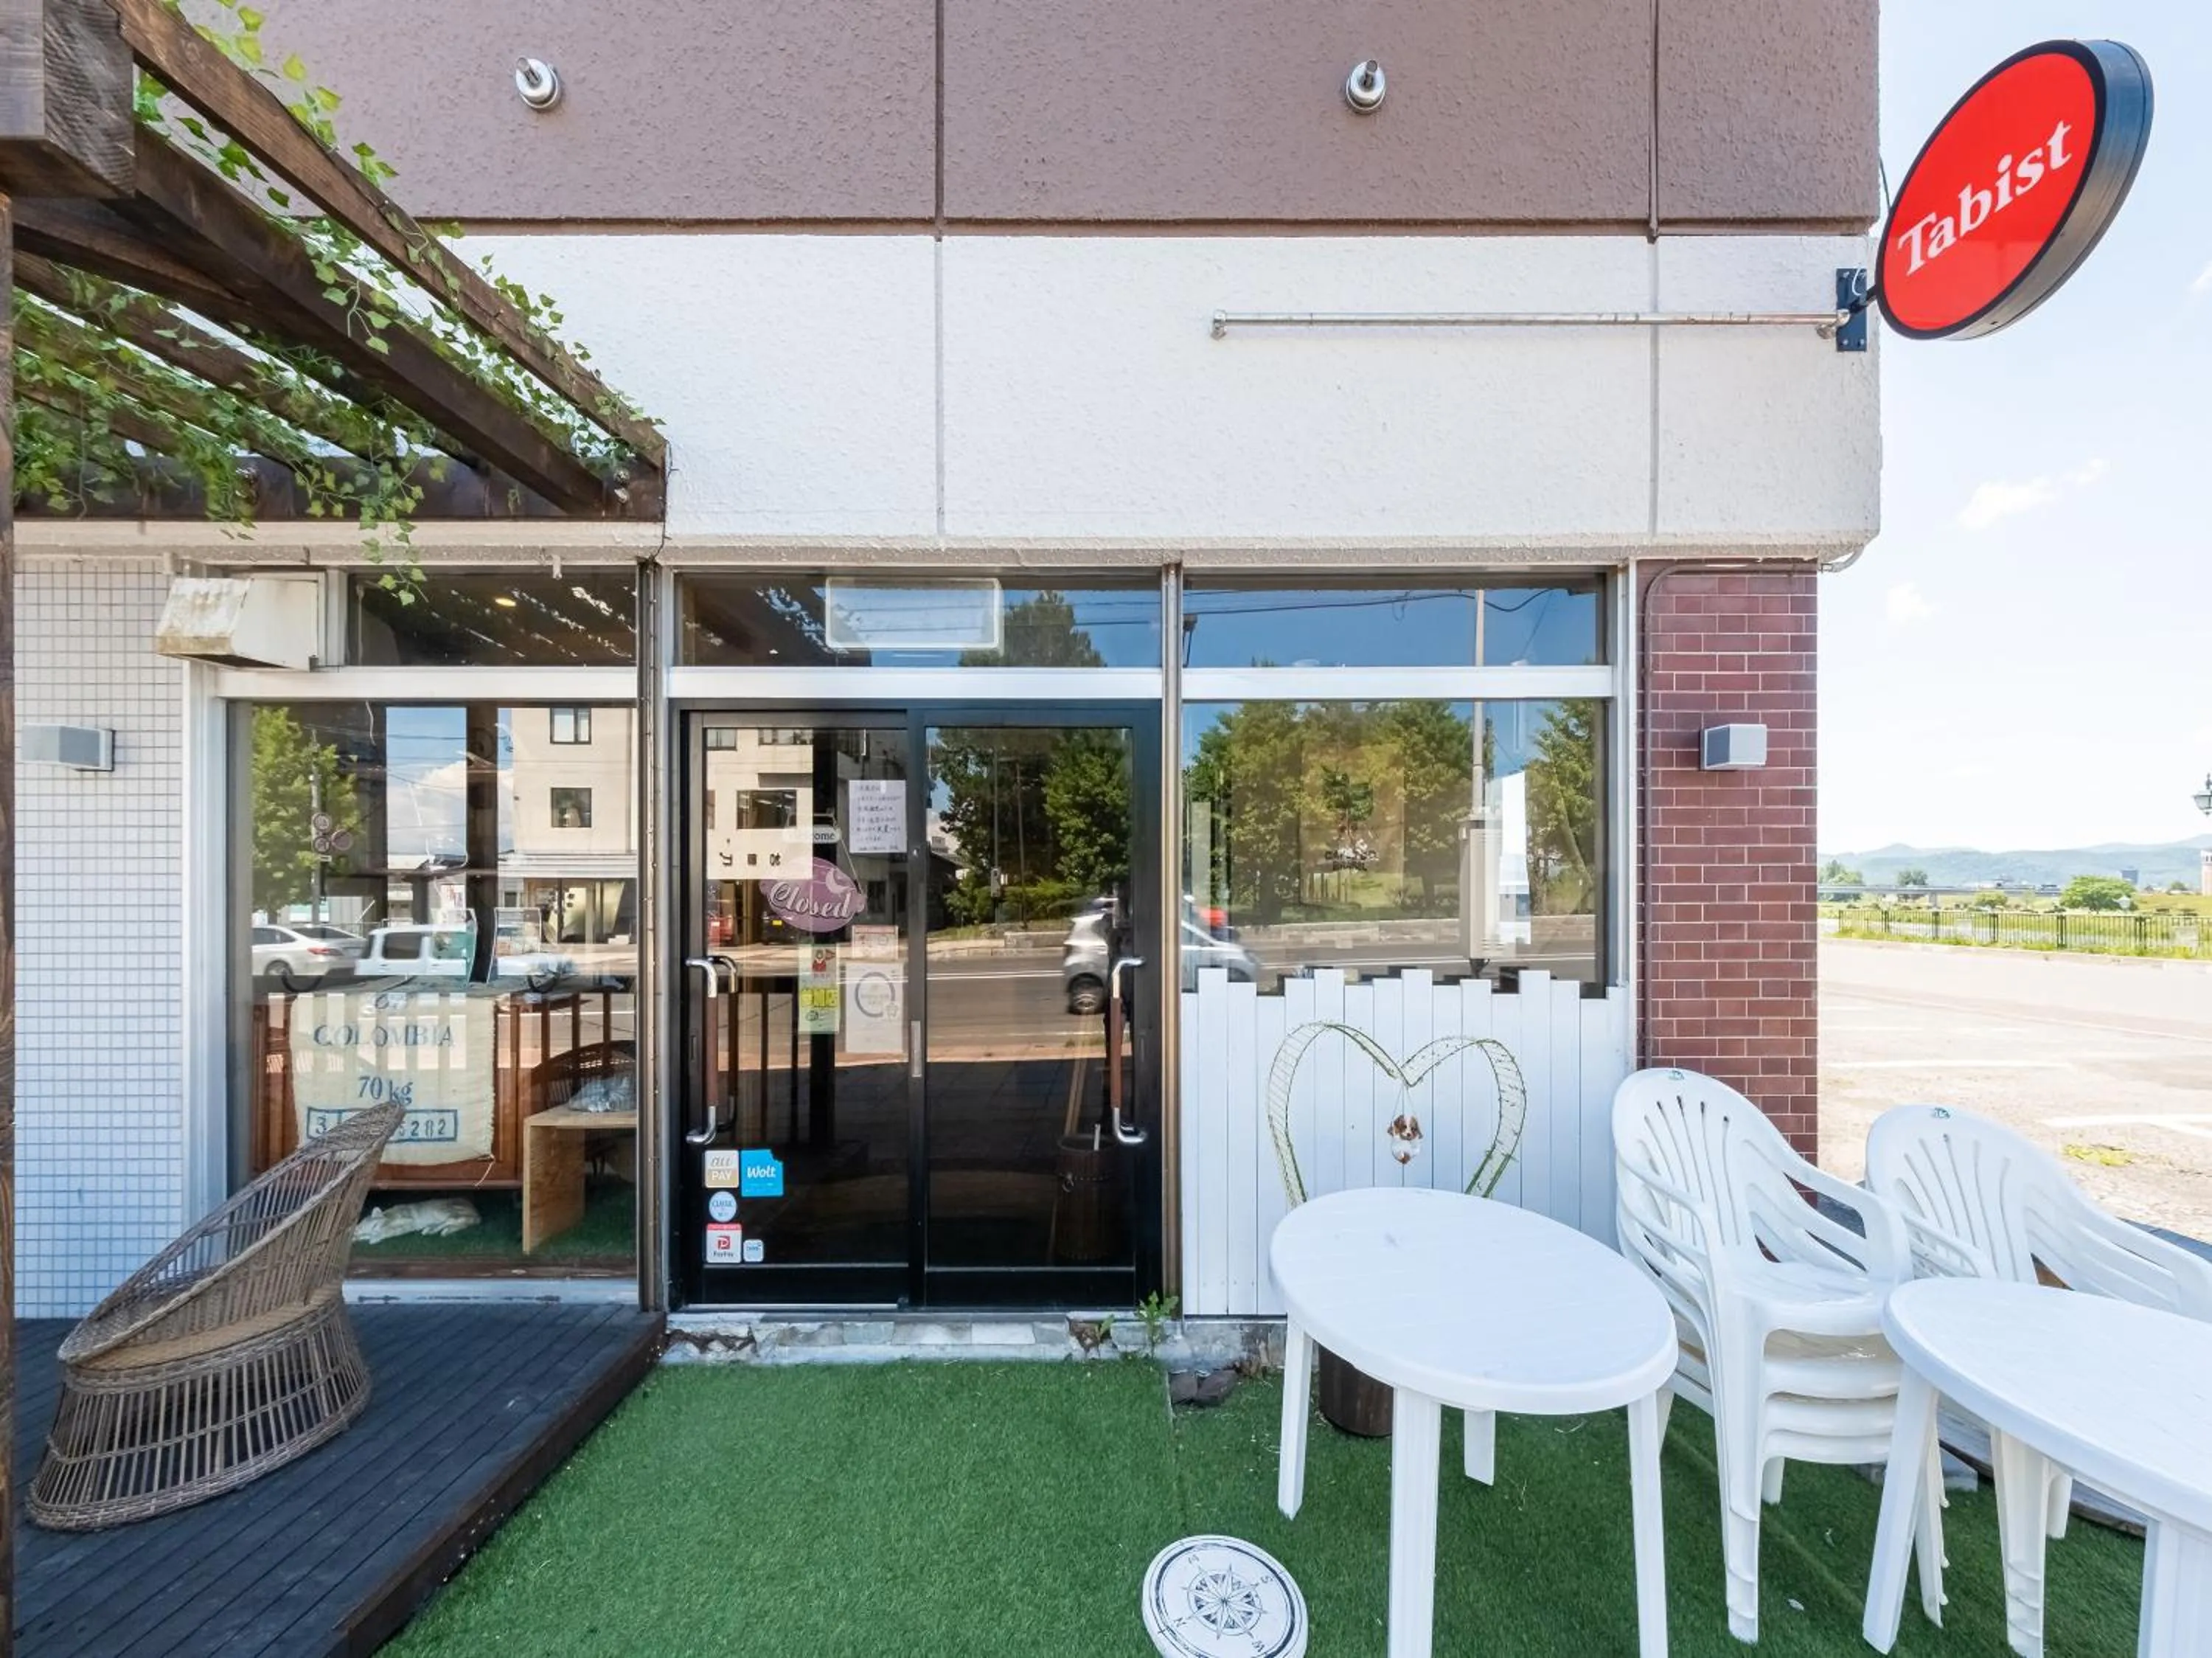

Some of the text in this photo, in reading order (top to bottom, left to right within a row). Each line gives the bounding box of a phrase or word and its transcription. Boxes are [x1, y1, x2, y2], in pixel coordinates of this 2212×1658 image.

[1897, 119, 2073, 277] Tabist
[769, 881, 852, 919] Closed
[313, 1024, 455, 1047] COLOMBIA
[357, 1075, 414, 1106] 70 kg
[712, 1171, 732, 1181] PAY
[747, 1165, 776, 1179] Wolt
